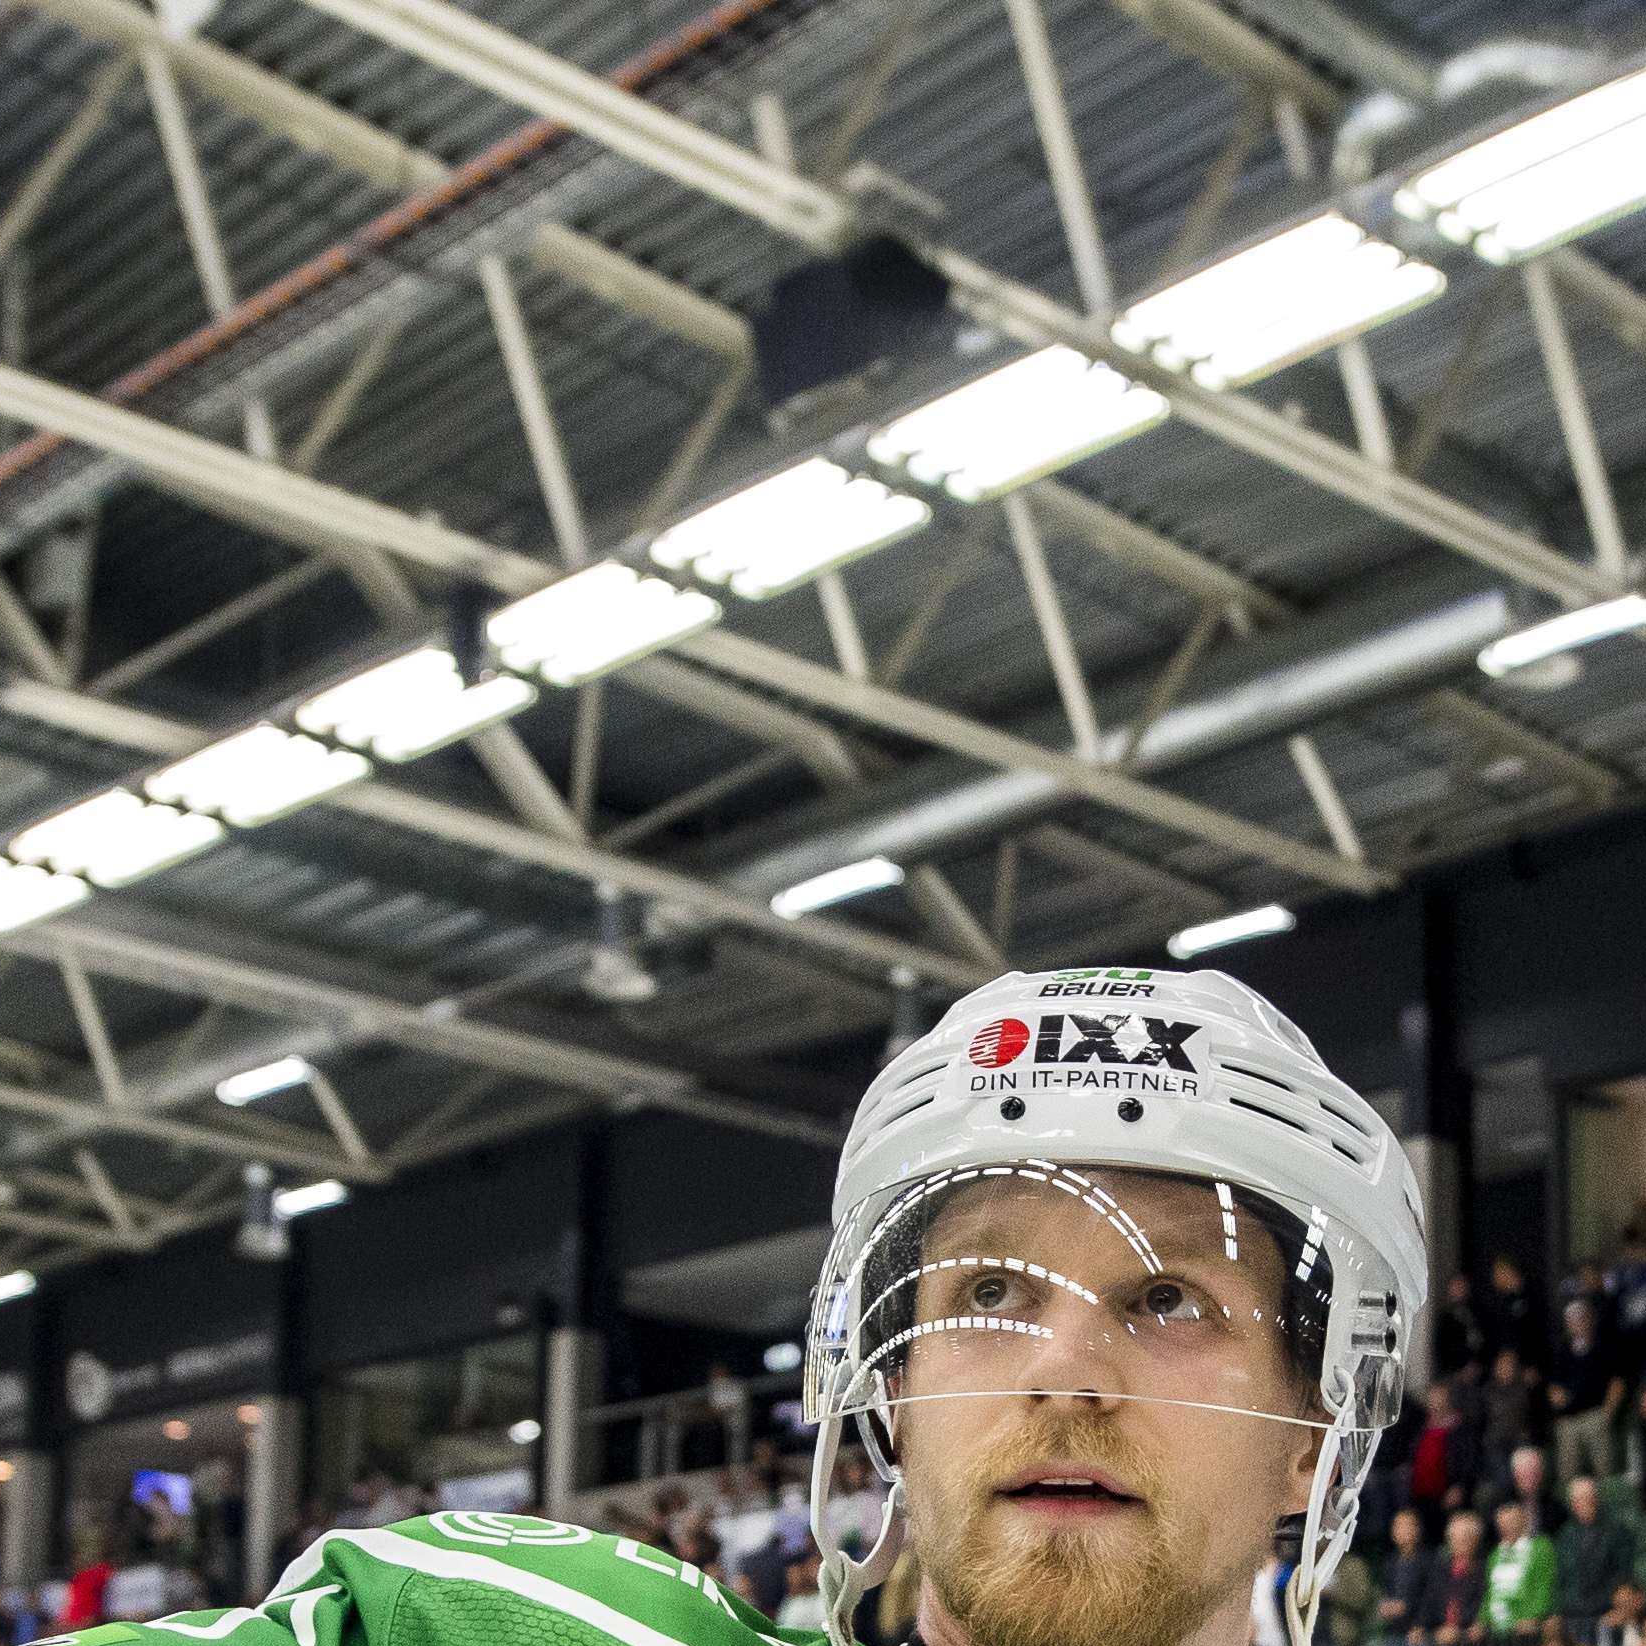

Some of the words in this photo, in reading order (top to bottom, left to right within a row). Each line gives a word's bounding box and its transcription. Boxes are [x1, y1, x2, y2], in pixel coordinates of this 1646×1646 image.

[1039, 981, 1156, 998] BAUER
[1033, 1012, 1206, 1074] IXX
[970, 1072, 1018, 1092] DIN
[1031, 1071, 1199, 1098] IT-PARTNER
